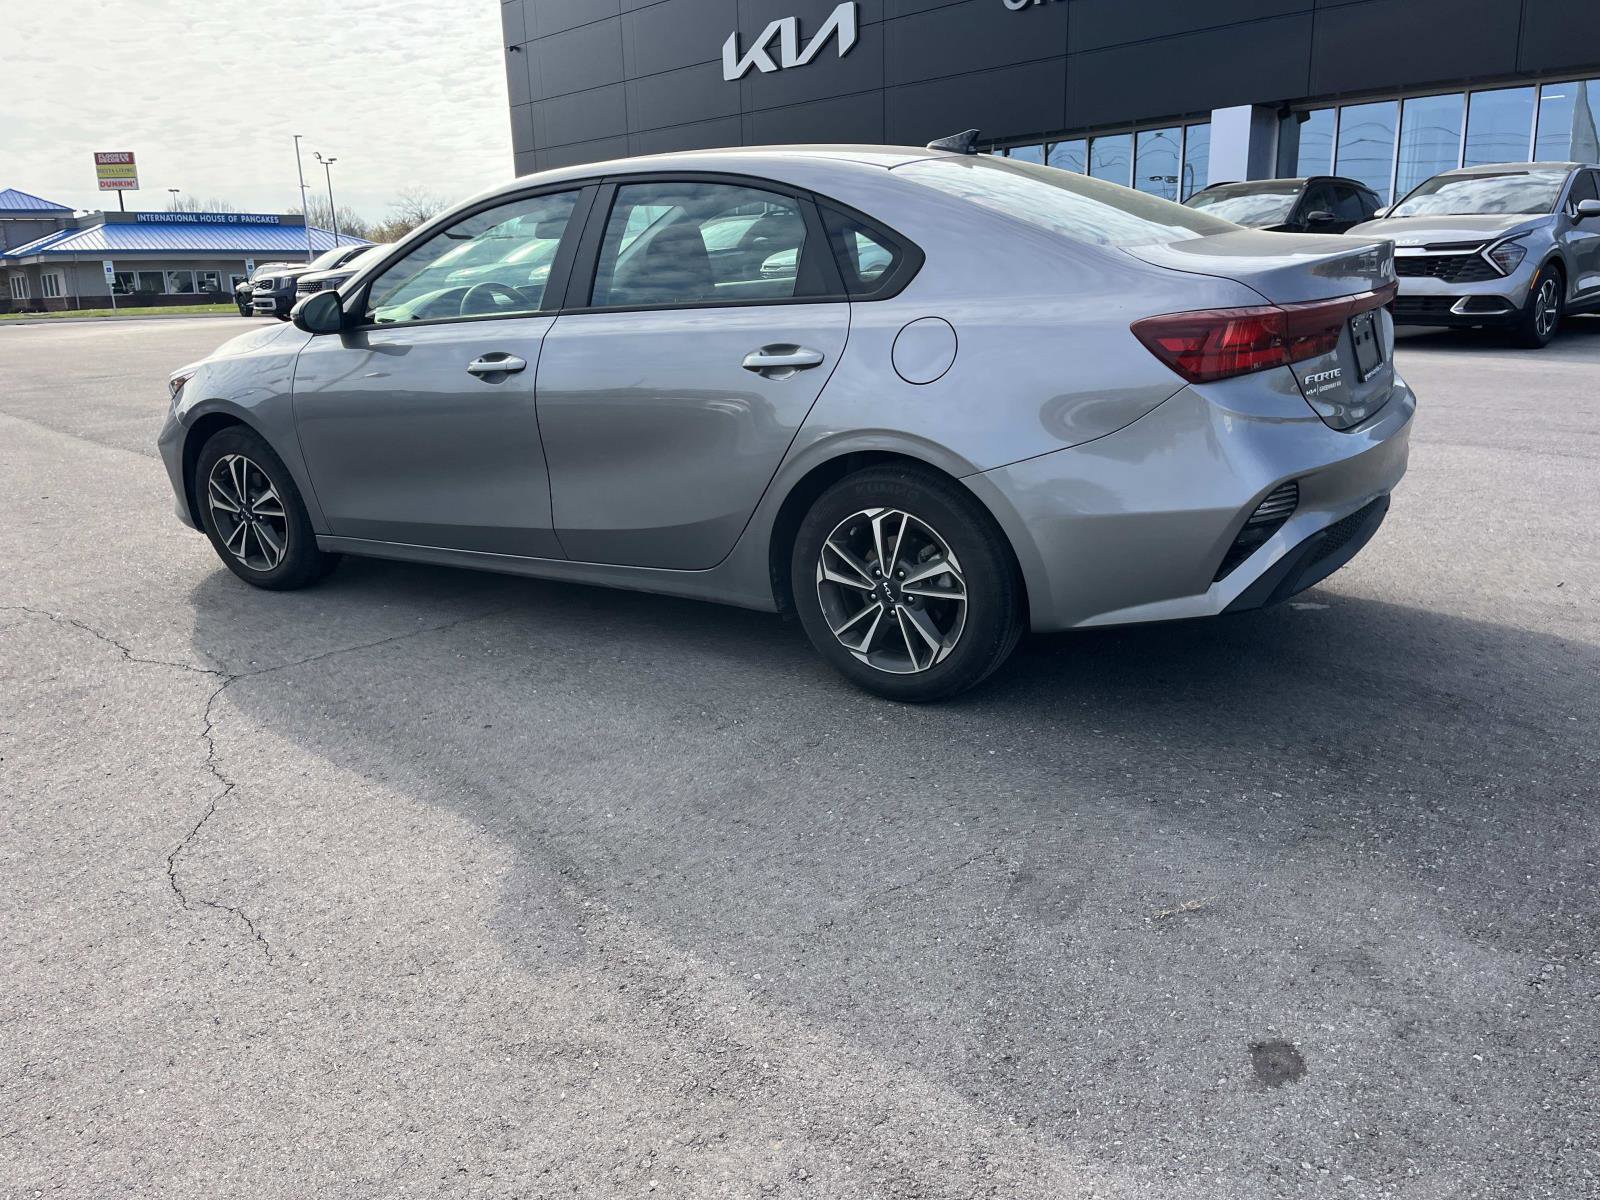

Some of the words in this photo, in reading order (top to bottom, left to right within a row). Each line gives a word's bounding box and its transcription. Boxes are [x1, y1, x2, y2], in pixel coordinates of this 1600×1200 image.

[722, 1, 859, 82] KIA
[137, 213, 198, 222] INTERNATIONAL
[200, 214, 226, 223] HOUSE
[228, 215, 238, 223] OF
[241, 215, 279, 224] PANCAKES
[1304, 367, 1342, 385] FORTE
